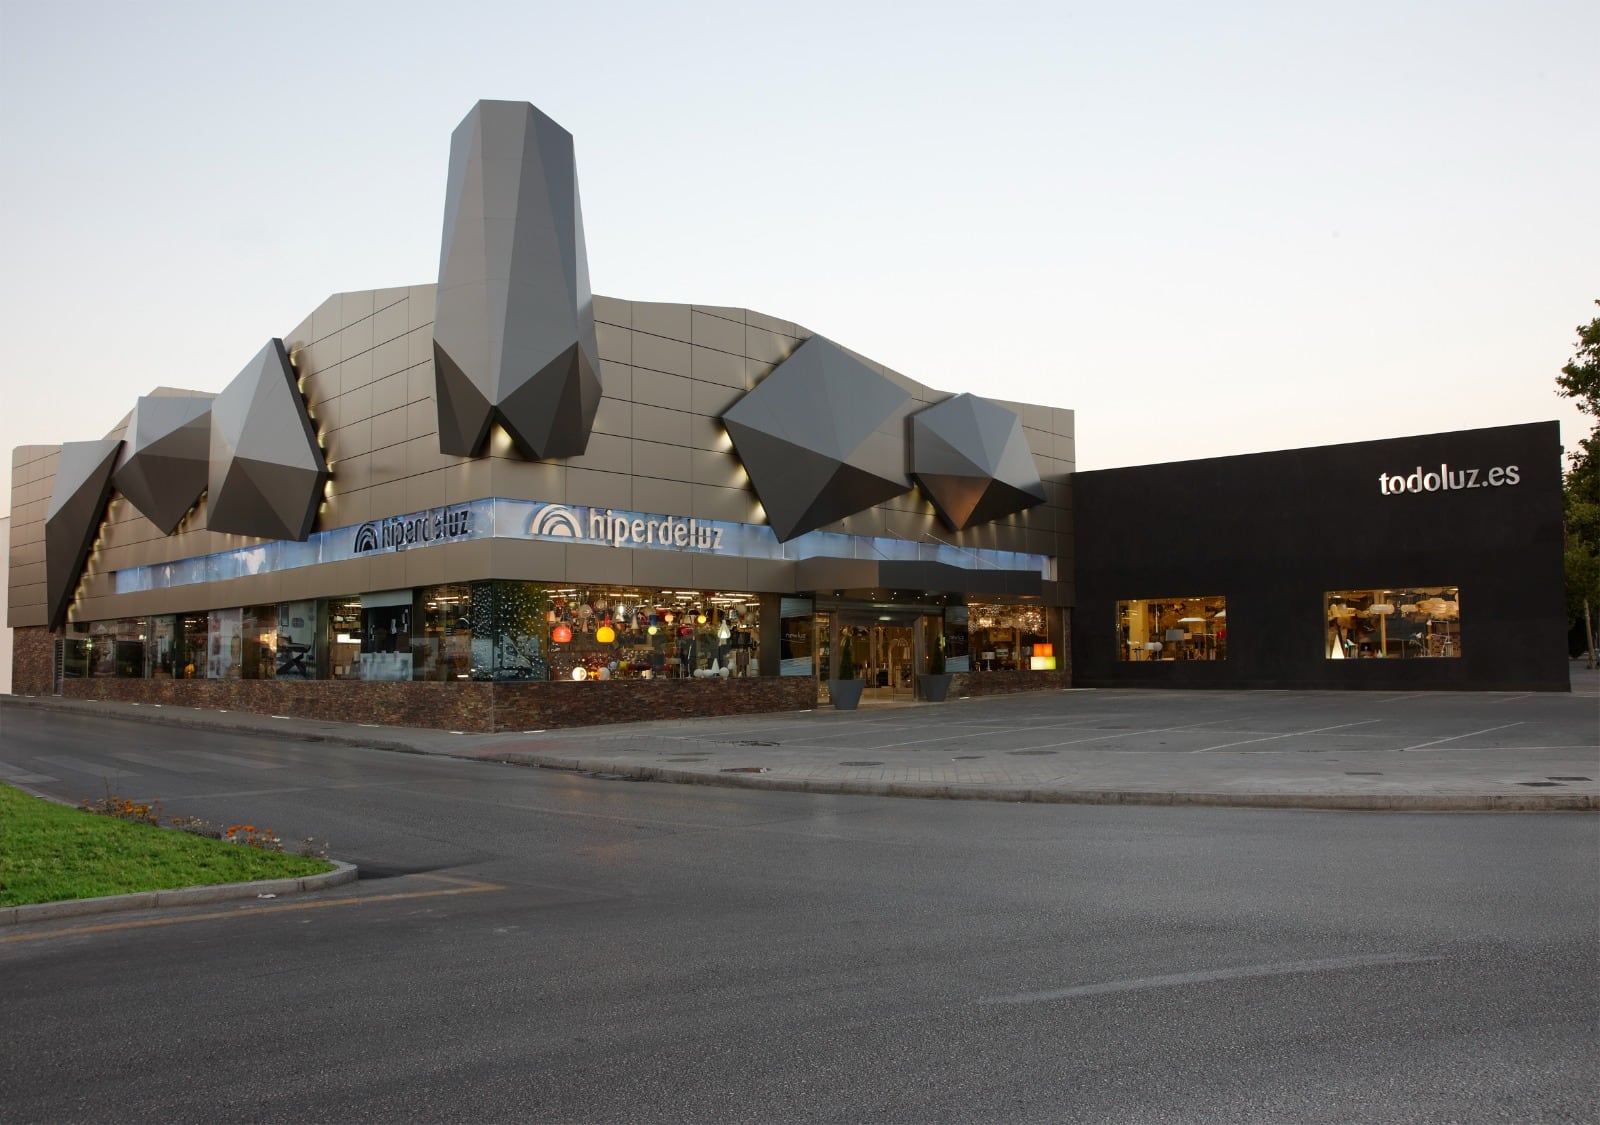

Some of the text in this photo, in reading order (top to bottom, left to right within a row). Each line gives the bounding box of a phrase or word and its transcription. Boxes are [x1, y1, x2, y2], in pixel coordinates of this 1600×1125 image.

[1379, 463, 1521, 496] todoluz.es
[382, 507, 470, 552] hiperdeluz
[589, 507, 724, 549] hiperdeluz
